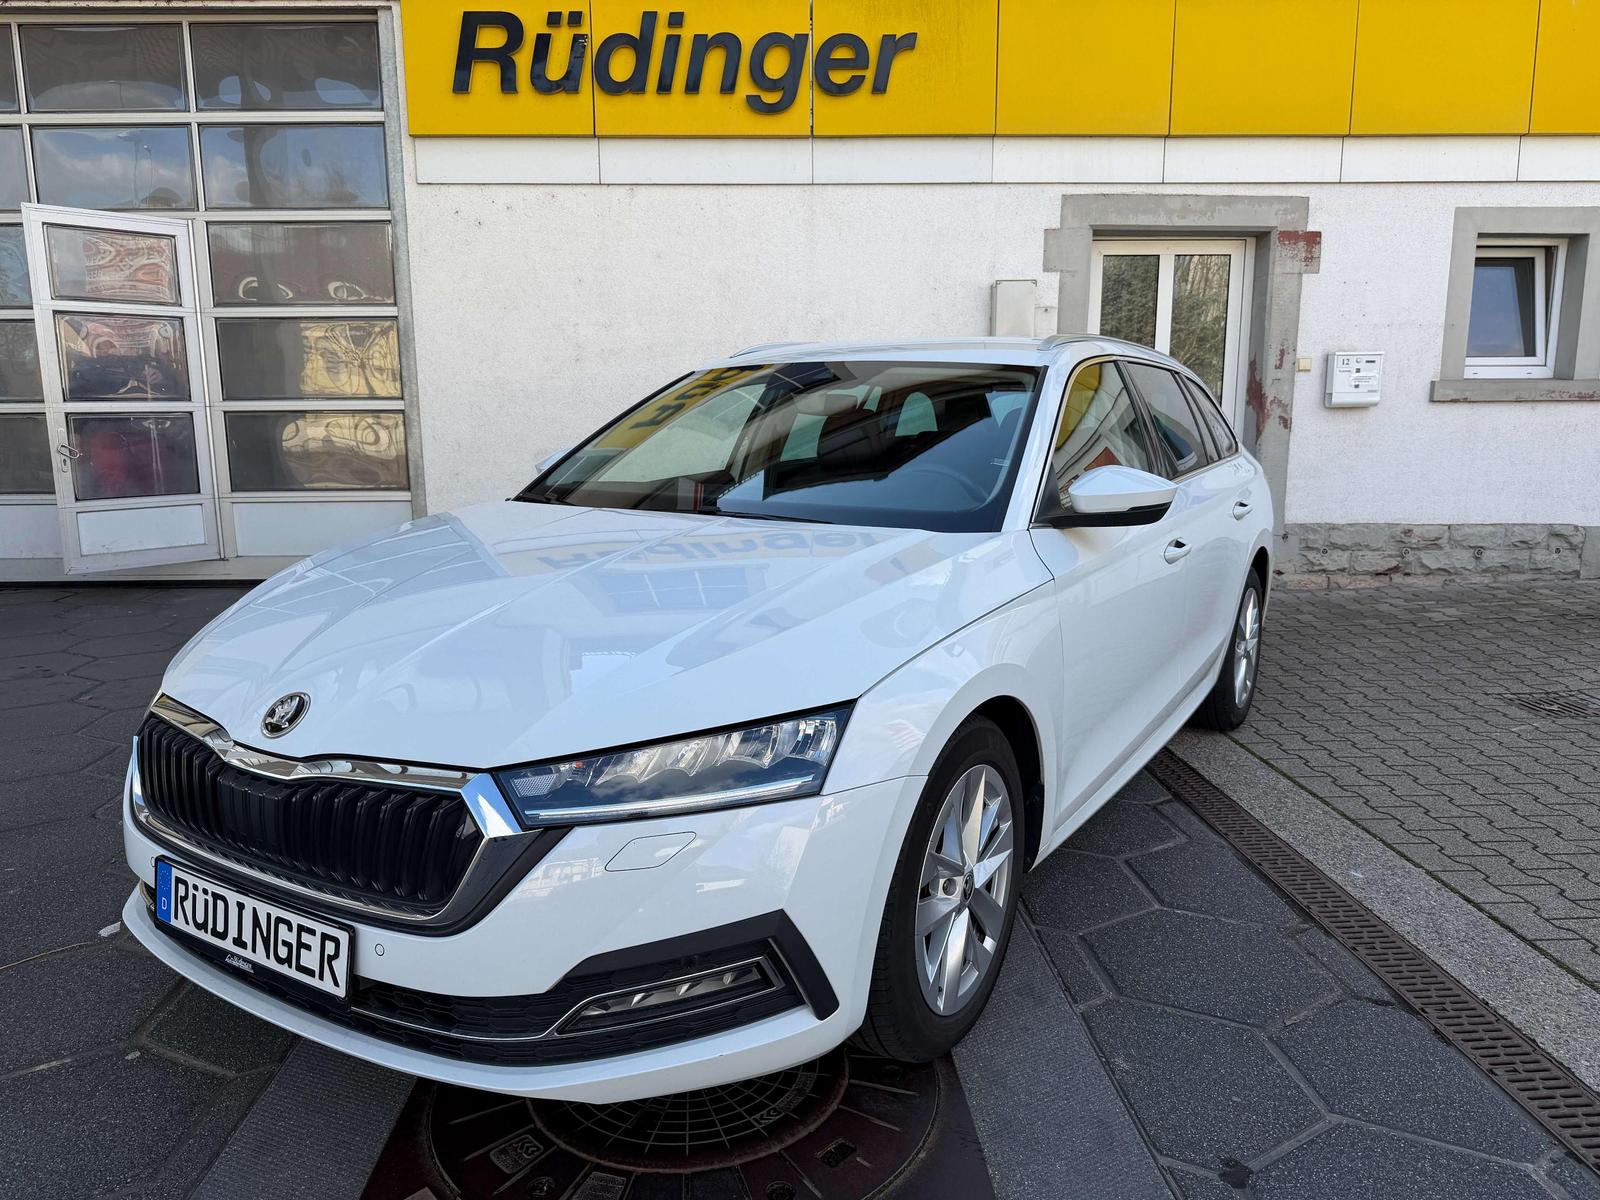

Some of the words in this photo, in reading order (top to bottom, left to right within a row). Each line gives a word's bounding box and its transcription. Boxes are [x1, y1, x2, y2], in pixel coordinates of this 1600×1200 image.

[452, 10, 918, 115] Rüdinger
[1341, 358, 1351, 366] 12
[161, 896, 168, 910] D
